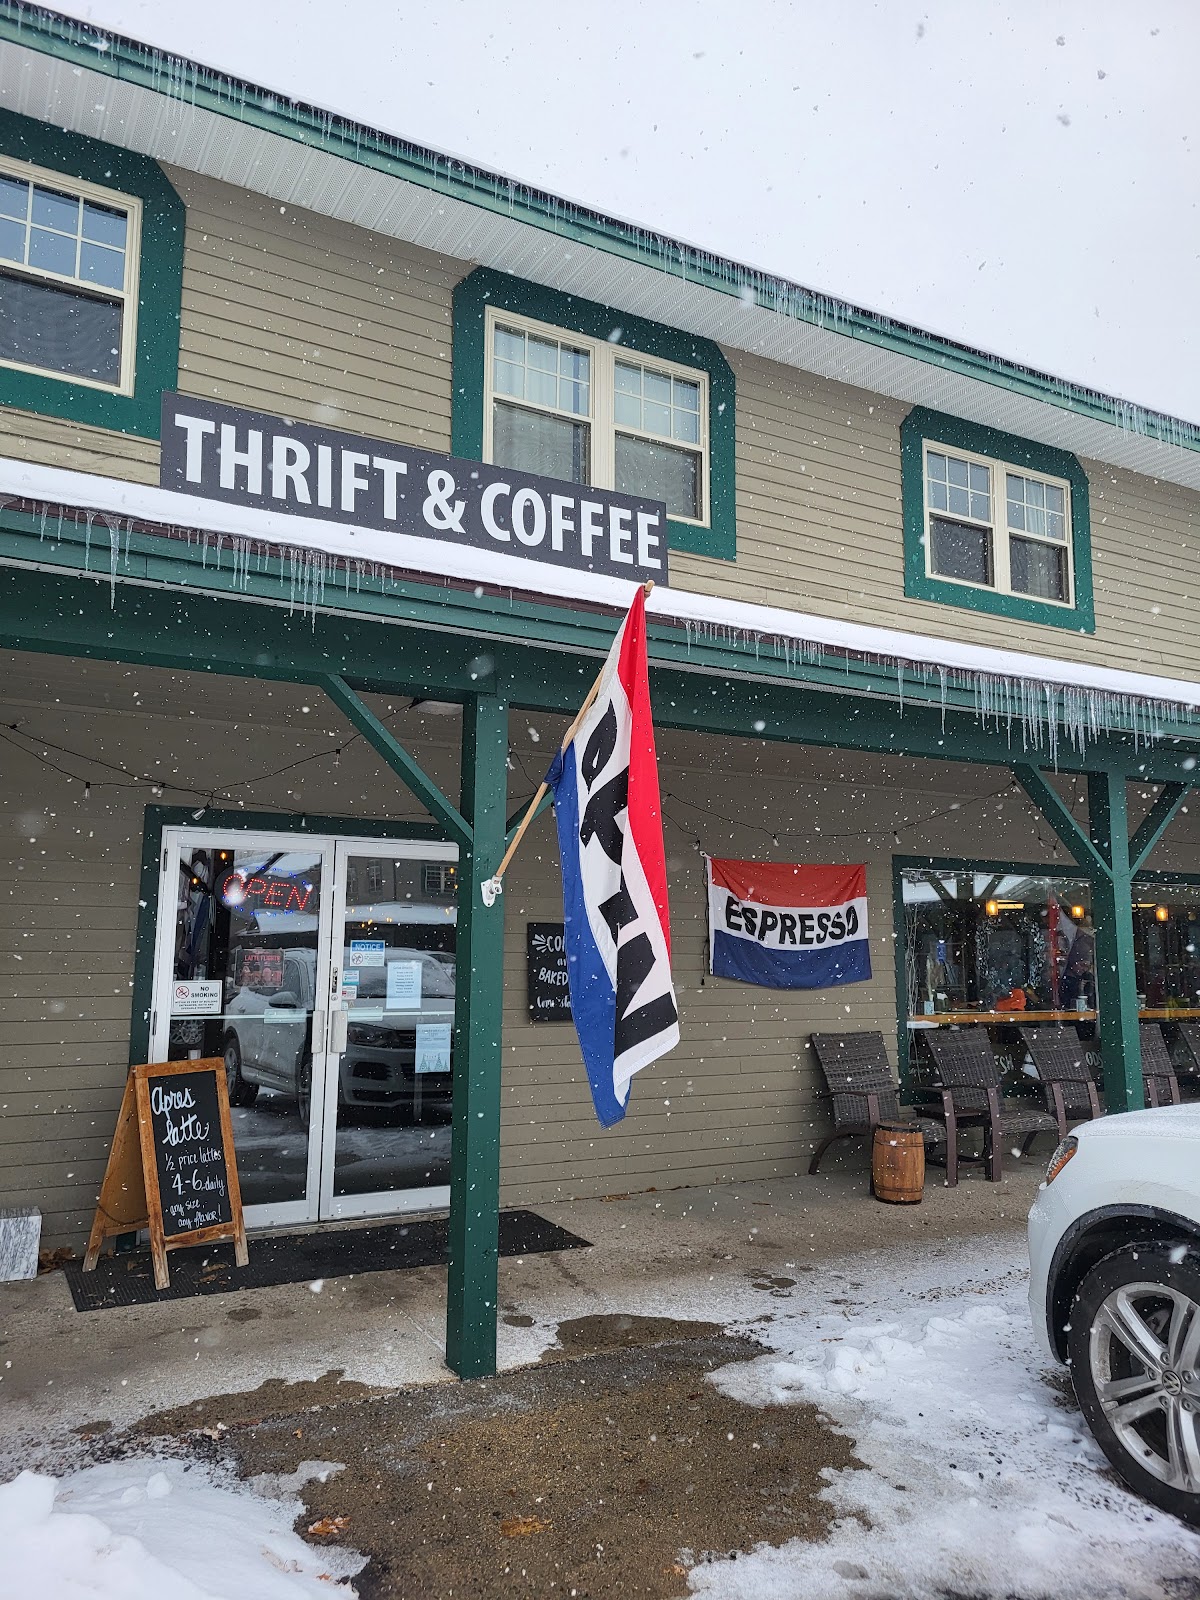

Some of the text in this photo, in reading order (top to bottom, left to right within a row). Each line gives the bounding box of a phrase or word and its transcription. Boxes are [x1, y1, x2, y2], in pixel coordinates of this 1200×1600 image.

[175, 413, 662, 570] THRIFT & COFFEE
[223, 873, 313, 911] OPEN
[725, 895, 859, 945] ESPRESSO
[354, 943, 382, 951] NOTICE
[538, 966, 569, 987] BAKED
[162, 1113, 210, 1146] latte
[178, 1153, 198, 1170] price
[199, 1146, 222, 1163] lattes
[169, 1203, 185, 1217] any
[177, 1217, 191, 1230] any
